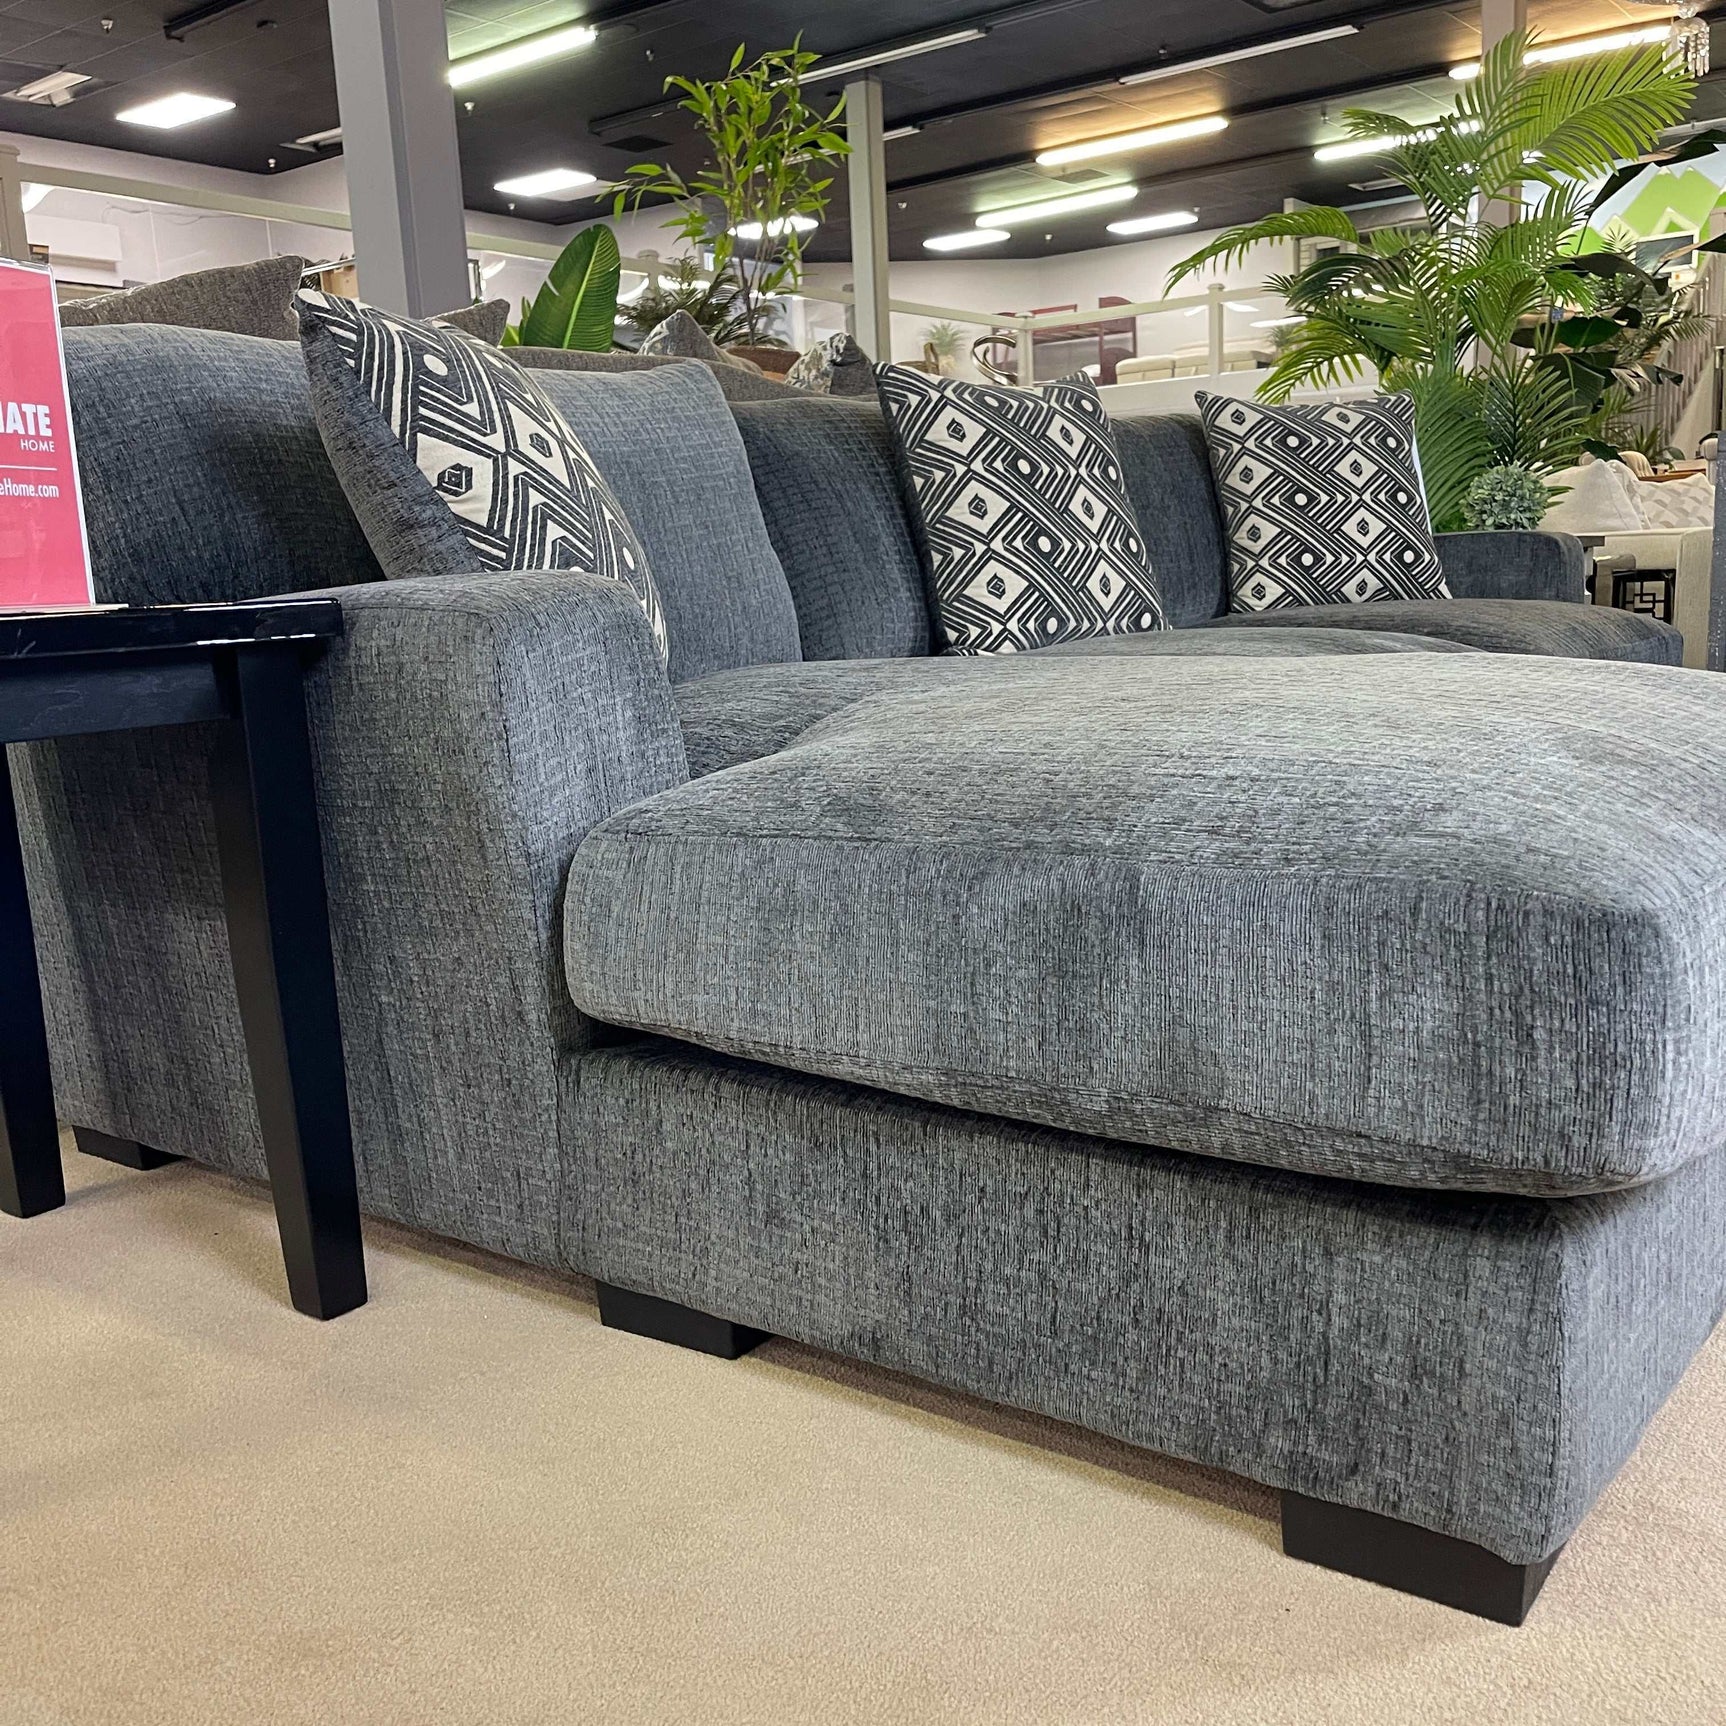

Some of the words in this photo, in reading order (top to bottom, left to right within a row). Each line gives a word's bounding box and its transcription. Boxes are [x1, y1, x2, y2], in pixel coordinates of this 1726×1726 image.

[0, 401, 53, 437] ATE
[20, 438, 56, 453] HOME
[0, 477, 60, 498] eHome.com
